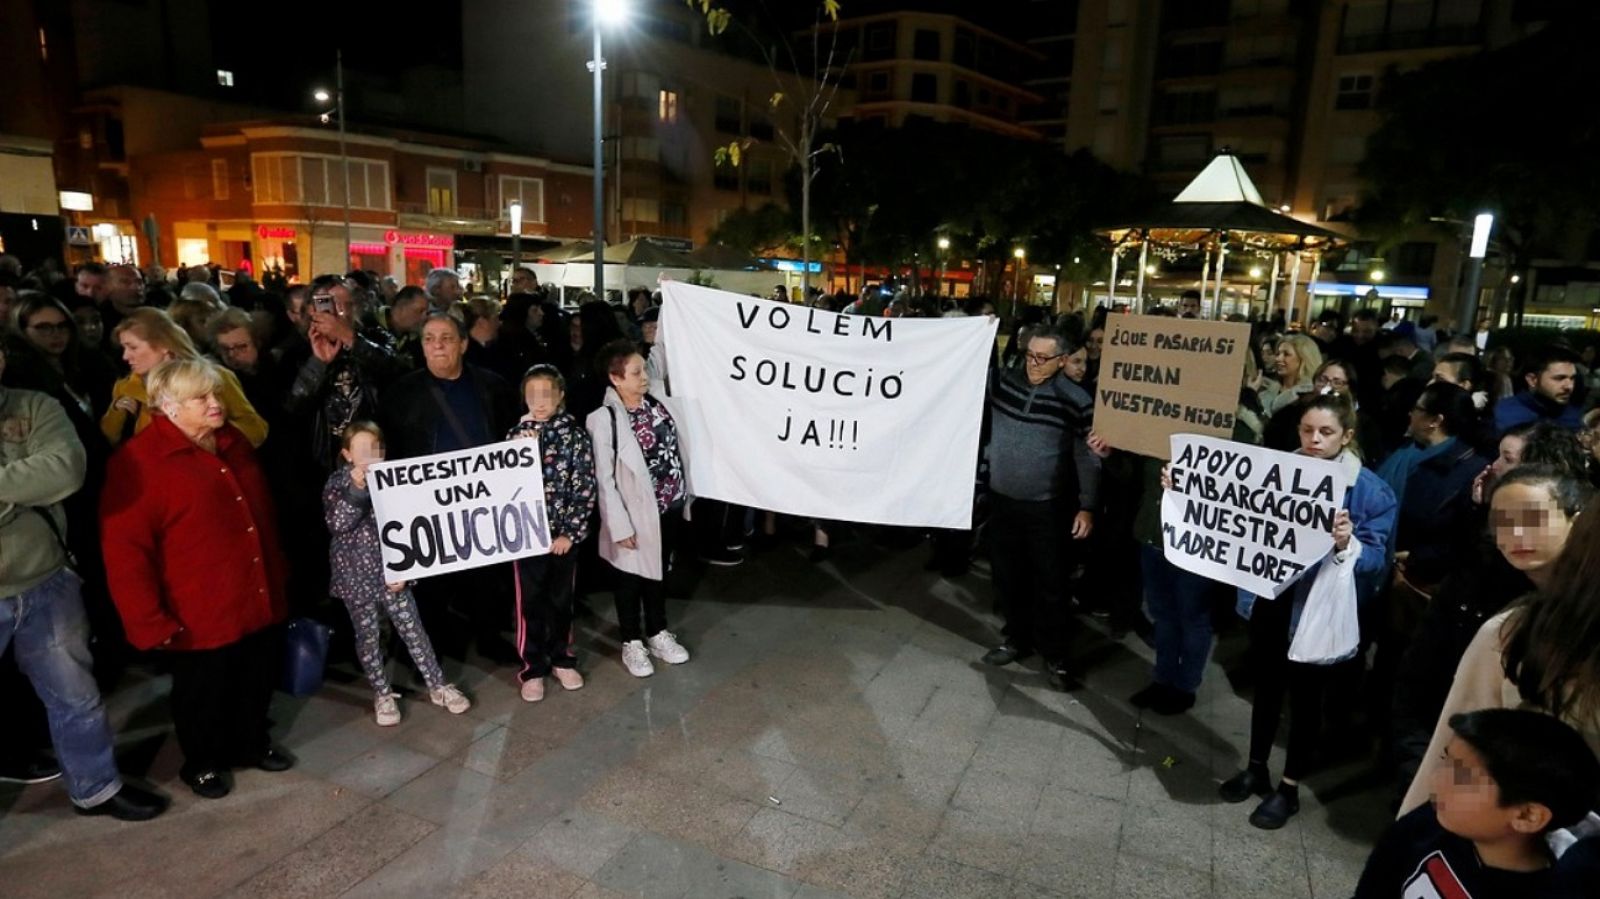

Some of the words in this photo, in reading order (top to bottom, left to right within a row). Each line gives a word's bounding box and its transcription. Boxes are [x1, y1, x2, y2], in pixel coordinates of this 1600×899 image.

[736, 302, 892, 341] VOLEM
[1111, 361, 1181, 385] FUERAN
[1100, 389, 1181, 418] VUESTROS
[374, 447, 534, 490] NECESITAMOS
[1176, 443, 1252, 481] APOYO
[1261, 463, 1283, 491] A
[1291, 468, 1334, 501] LA
[434, 480, 492, 506] UNA
[1170, 468, 1337, 533] EMBARCACIÓN
[381, 487, 549, 572] SOLUCIÓN
[1163, 521, 1231, 565] MADRE
[1183, 499, 1296, 553] NUESTRA
